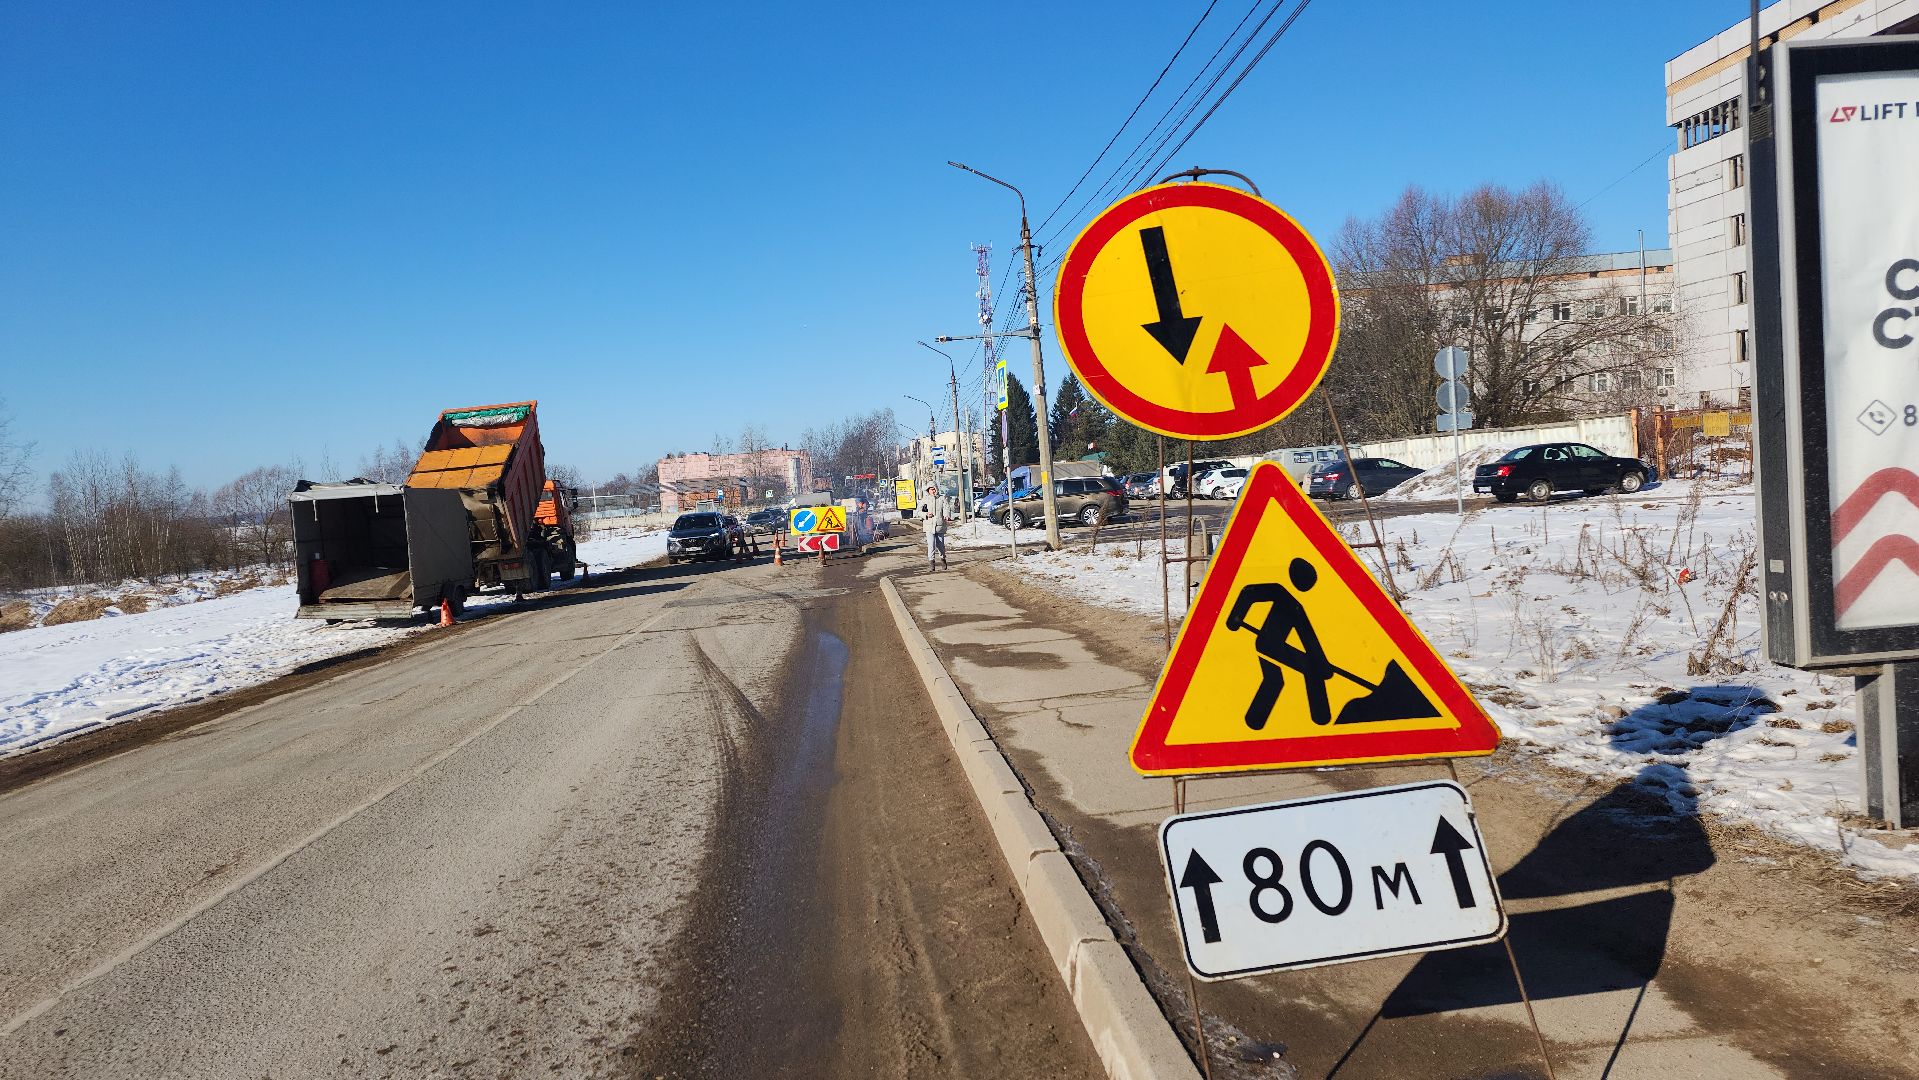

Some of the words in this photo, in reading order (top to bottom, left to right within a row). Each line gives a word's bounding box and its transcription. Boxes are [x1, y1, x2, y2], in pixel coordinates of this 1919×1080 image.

[1860, 102, 1908, 121] LIFT
[1903, 404, 1918, 427] 8
[1242, 839, 1353, 924] 80
